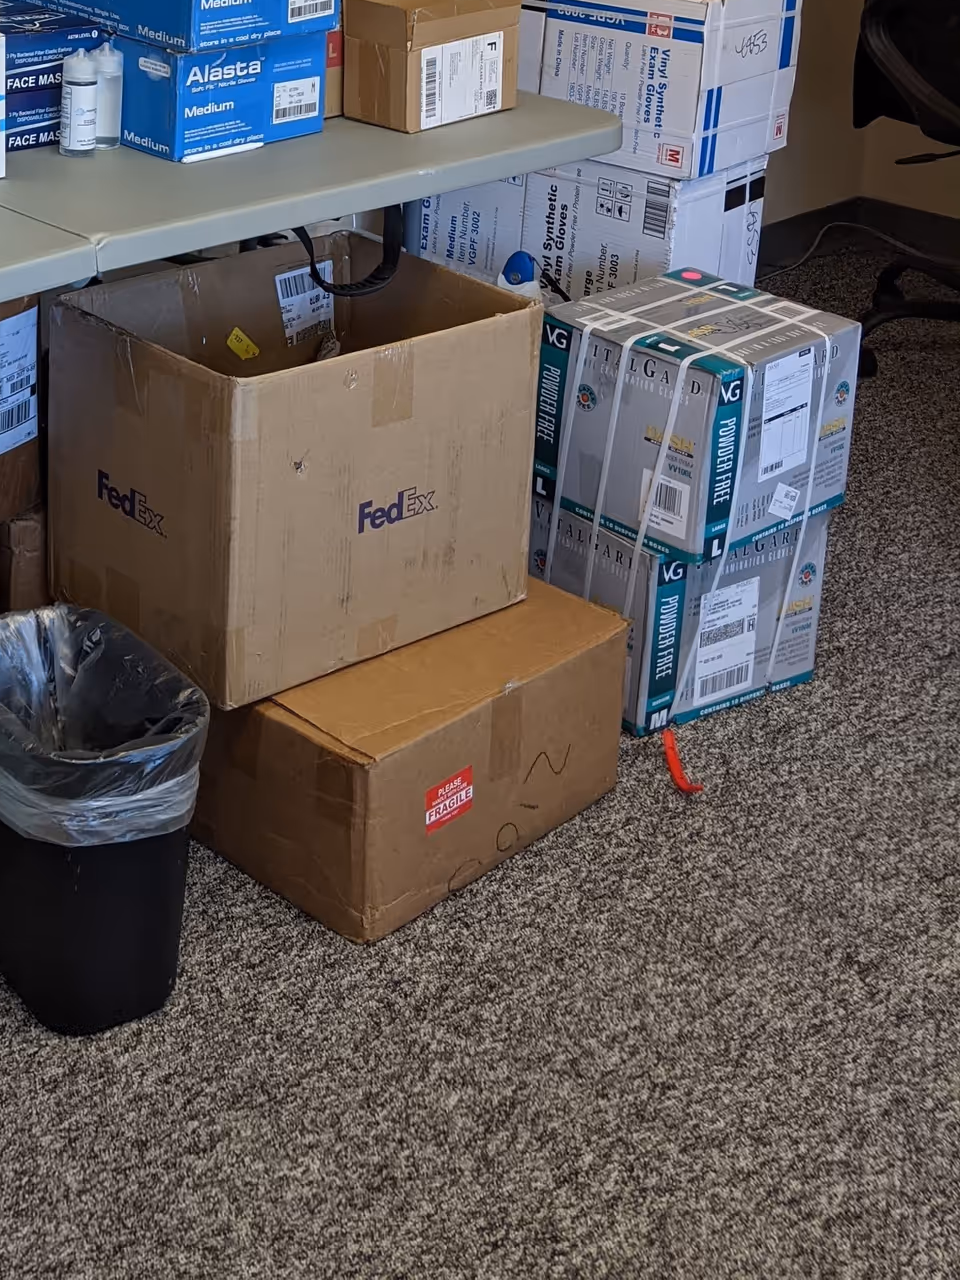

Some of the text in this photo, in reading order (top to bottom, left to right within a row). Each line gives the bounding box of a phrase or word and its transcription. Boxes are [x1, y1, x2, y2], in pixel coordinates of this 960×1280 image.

[137, 24, 186, 48] Medium
[486, 41, 497, 51] F
[328, 44, 338, 58] L
[659, 48, 671, 80] Vinyl
[6, 72, 62, 90] FACE MAS
[643, 46, 659, 124] Exam Gloves
[184, 100, 234, 118] Medium
[8, 130, 61, 148] FACE MAS
[124, 129, 170, 155] Medium
[667, 148, 680, 163] M
[542, 184, 559, 251] Synthetic
[445, 214, 457, 259] Medium
[467, 211, 481, 266] VGPF 3002
[550, 202, 568, 288] xam Gloves
[608, 253, 620, 279] 3003
[546, 324, 568, 349] VG
[537, 363, 561, 445] POWDER FREE
[721, 380, 740, 403] VG
[713, 416, 737, 507] POWDER FREE
[536, 476, 547, 496] L
[97, 470, 165, 537] FedEx
[357, 486, 436, 535] FedEx
[711, 538, 722, 557] L
[663, 561, 683, 582] VG
[655, 595, 679, 681] POWDER FREE
[649, 708, 668, 730] M
[437, 777, 462, 797] PLEASE
[428, 787, 471, 822] FRAGILE
